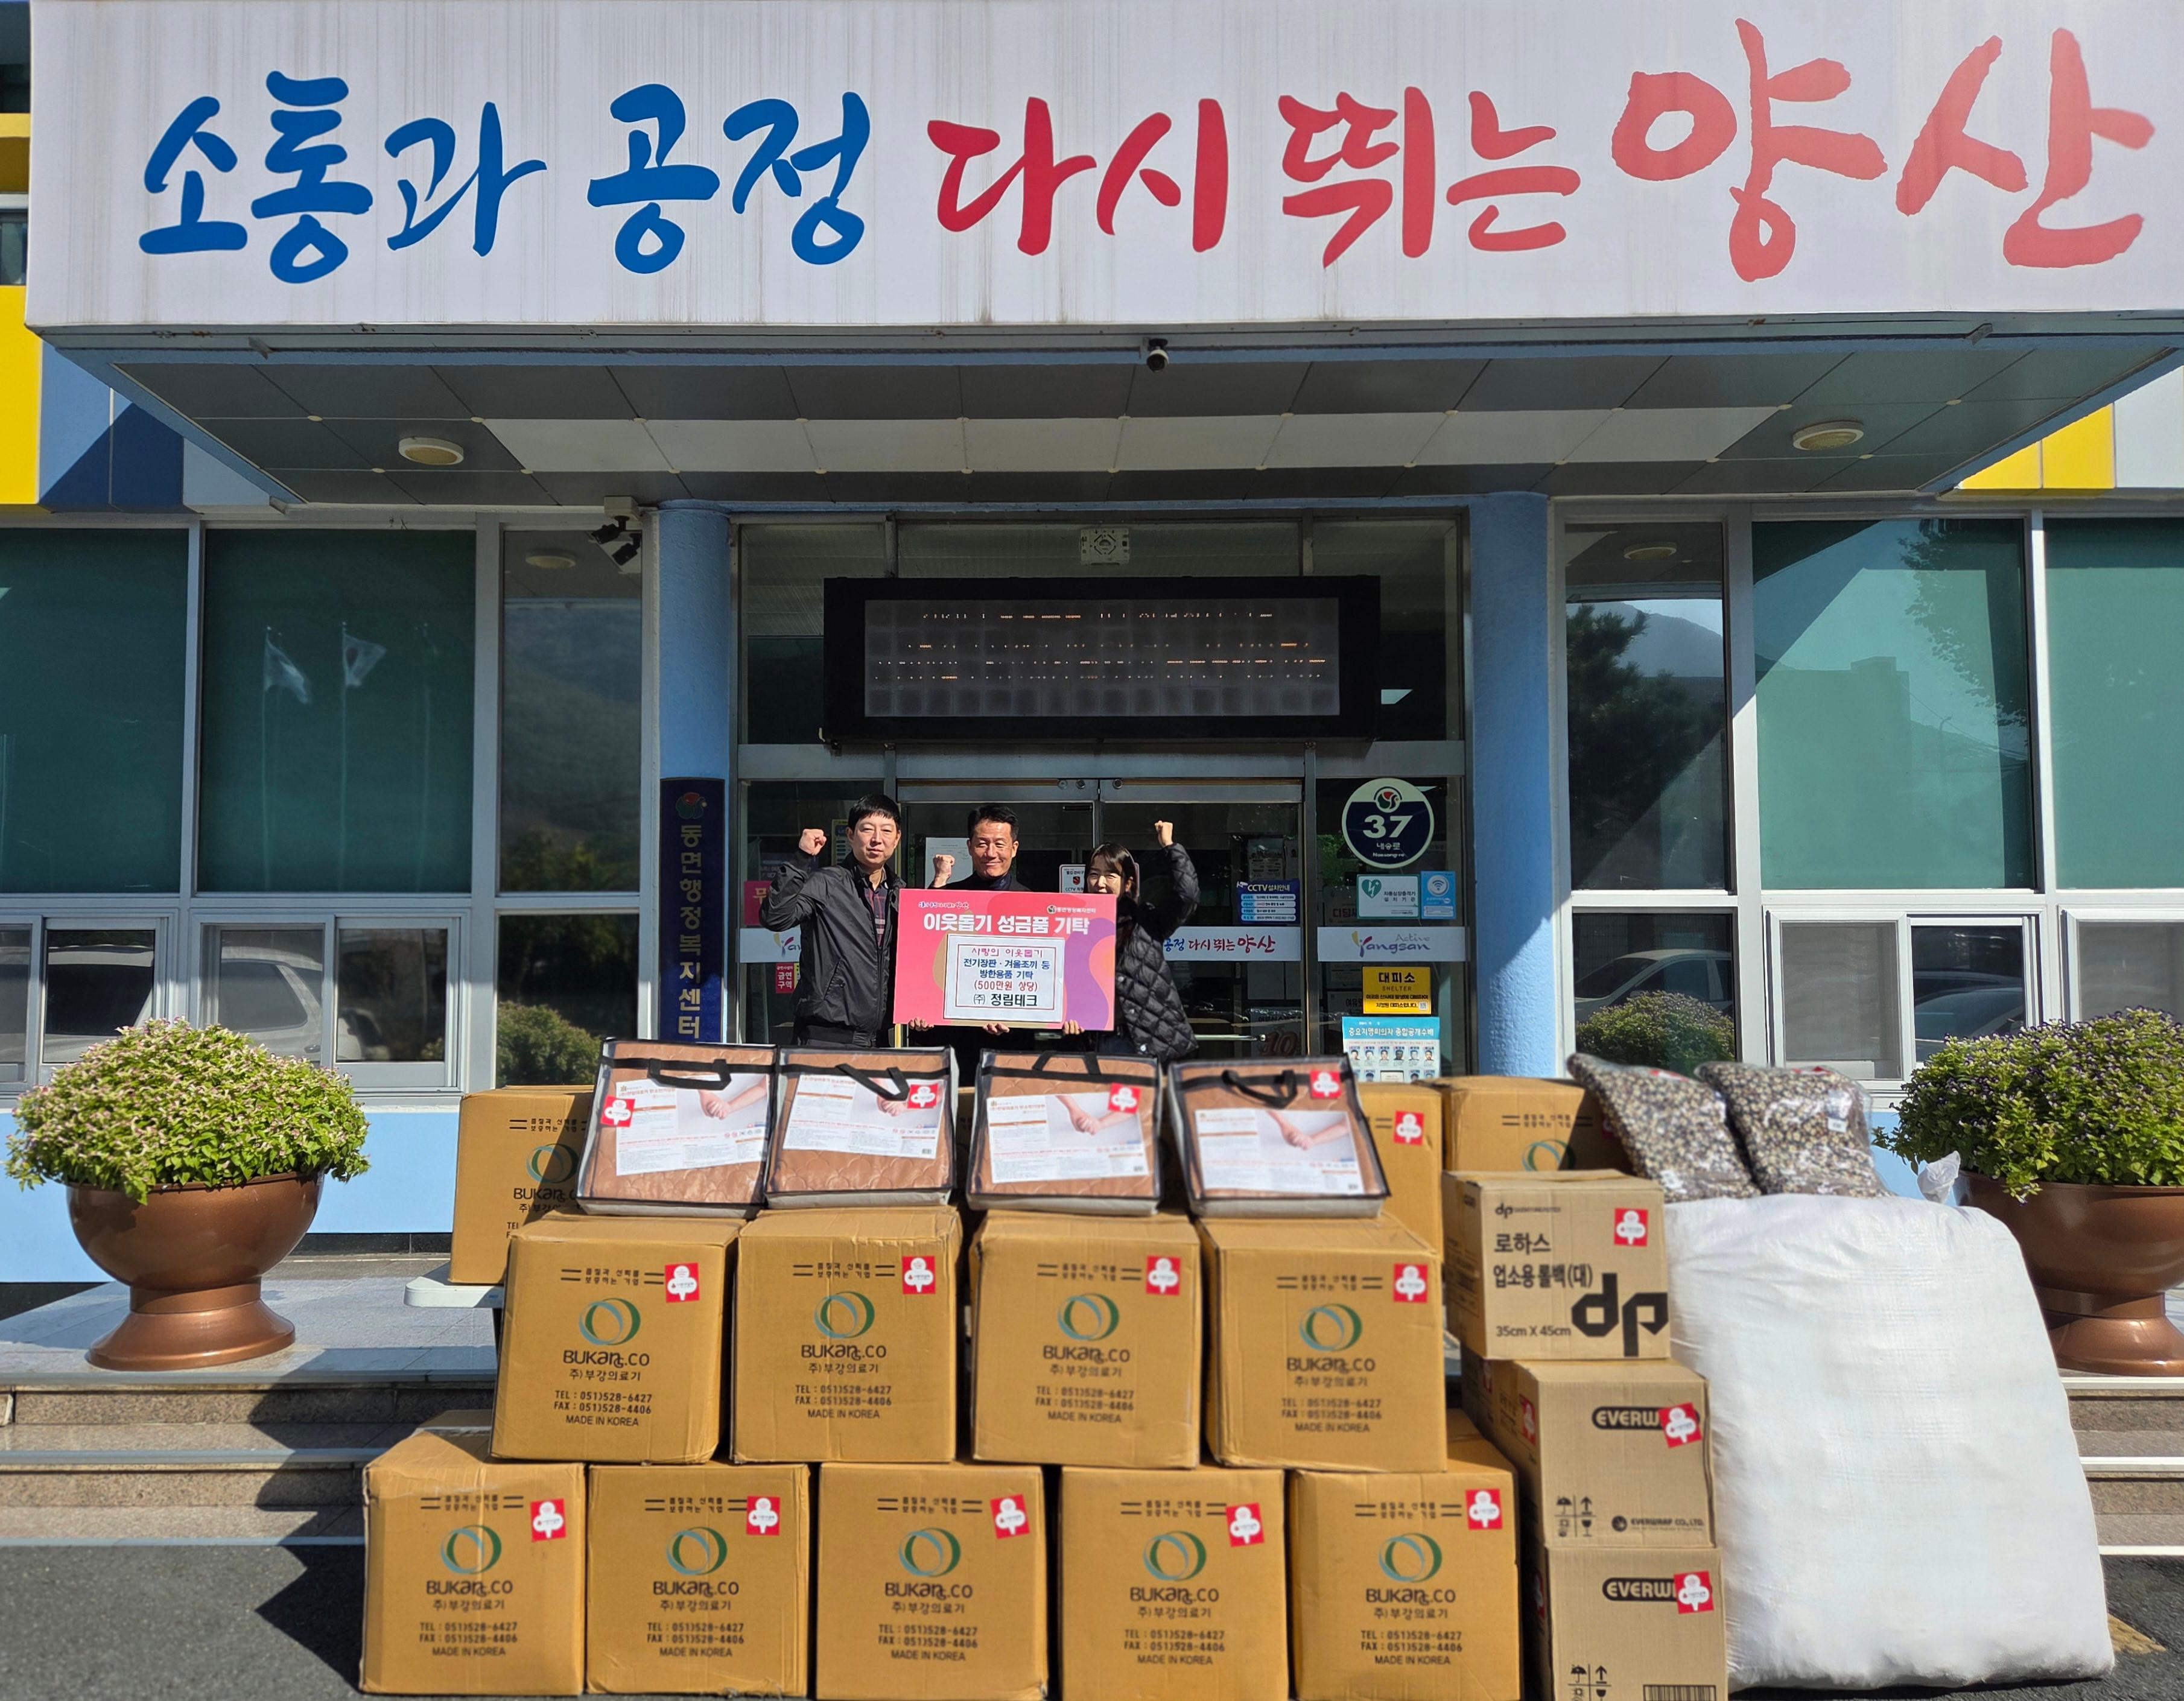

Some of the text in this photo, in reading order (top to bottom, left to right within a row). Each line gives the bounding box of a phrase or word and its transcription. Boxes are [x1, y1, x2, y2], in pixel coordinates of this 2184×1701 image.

[139, 18, 2156, 285] 소통과 공정 다시 뛰는 양산
[1363, 815, 1413, 838] 37
[924, 914, 1090, 934] 이웃돕기 성금품 기탁
[678, 825, 703, 1039] 동면행정복지센터
[1395, 933, 1430, 942] Active
[1164, 934, 1275, 953] 공정 다시 뛰는 양산
[1351, 931, 1430, 958] Yangsan
[972, 948, 999, 957] 사랑의
[963, 958, 996, 968] 전기장판
[1005, 960, 1037, 969] 겨울조끼
[1041, 961, 1050, 969] 등
[778, 972, 792, 980] 금연
[980, 970, 1012, 978] 방한용품
[1379, 972, 1415, 983] 대피소
[778, 981, 792, 989] 구역
[974, 980, 1038, 992] (500만원 상당)
[991, 994, 1037, 1006] 정림테크
[1494, 1232, 1551, 1255] 로하스
[1494, 1264, 1534, 1288] 업소용
[1496, 1326, 1527, 1337] 35cm
[1540, 1326, 1571, 1336] 45cm
[796, 1385, 810, 1393] TEL
[1037, 1386, 1051, 1395] TEL
[556, 1390, 570, 1399] TEL
[553, 1401, 570, 1410] FAX
[1036, 1398, 1051, 1406] FAX
[1281, 1398, 1297, 1407] TEL
[808, 1410, 880, 1419] MADE IN KOREA
[1048, 1411, 1122, 1422] MADE IN KOREA
[1596, 1411, 1660, 1427] EVERW
[566, 1416, 639, 1426] MADE IN KOREA
[1295, 1422, 1370, 1432] MADE IN KOREA
[1607, 1583, 1675, 1598] EVERW
[420, 1623, 434, 1631] TEL
[647, 1623, 662, 1631] TEL
[878, 1624, 894, 1633] TEL
[420, 1634, 435, 1642] FAX
[647, 1634, 662, 1642] FAX
[1125, 1630, 1140, 1638] TEL
[1361, 1630, 1377, 1639] TEL
[878, 1636, 894, 1644] FAX
[1125, 1641, 1140, 1650] FAX
[474, 1647, 506, 1656] KOREA
[660, 1647, 732, 1657] MADE IN KOREA
[891, 1650, 965, 1661] MADE IN KOREA
[1138, 1655, 1213, 1665] MADE IN KOREA
[1375, 1656, 1450, 1665] MADE IN KOREA
